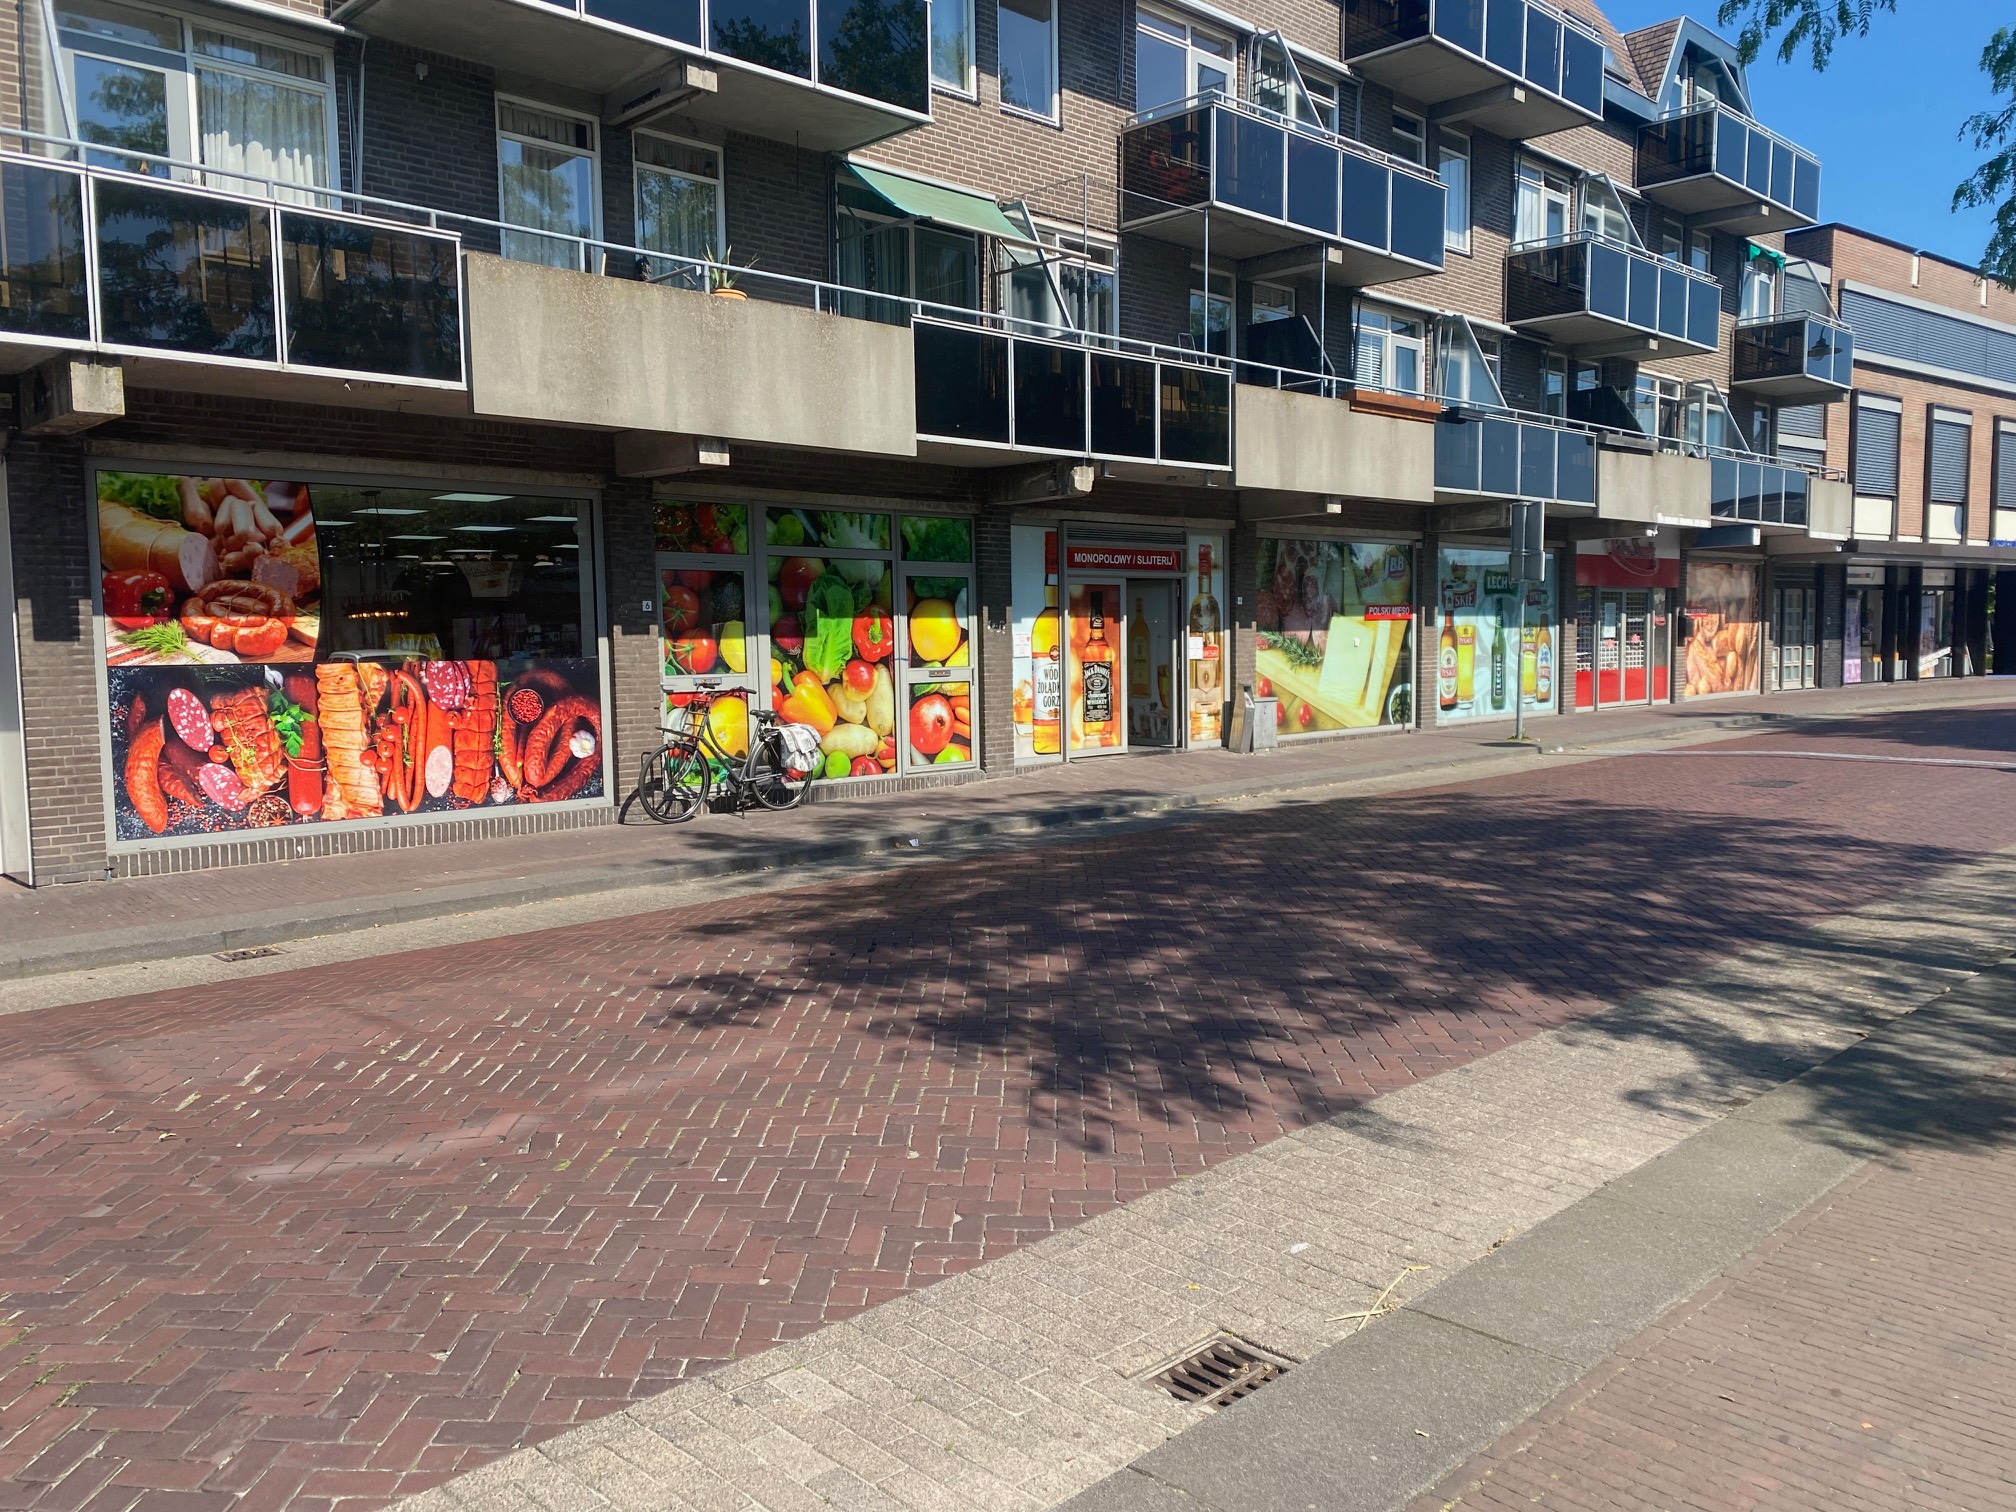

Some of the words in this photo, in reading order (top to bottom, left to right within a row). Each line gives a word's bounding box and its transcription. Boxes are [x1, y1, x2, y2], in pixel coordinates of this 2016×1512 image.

[1074, 552, 1131, 564] MONOPOLOWY
[1132, 555, 1136, 564] /
[1137, 555, 1173, 565] SLIJTERIJ
[1487, 575, 1508, 589] LECH
[1453, 592, 1474, 606] SKIE
[1369, 606, 1391, 616] POLSKI
